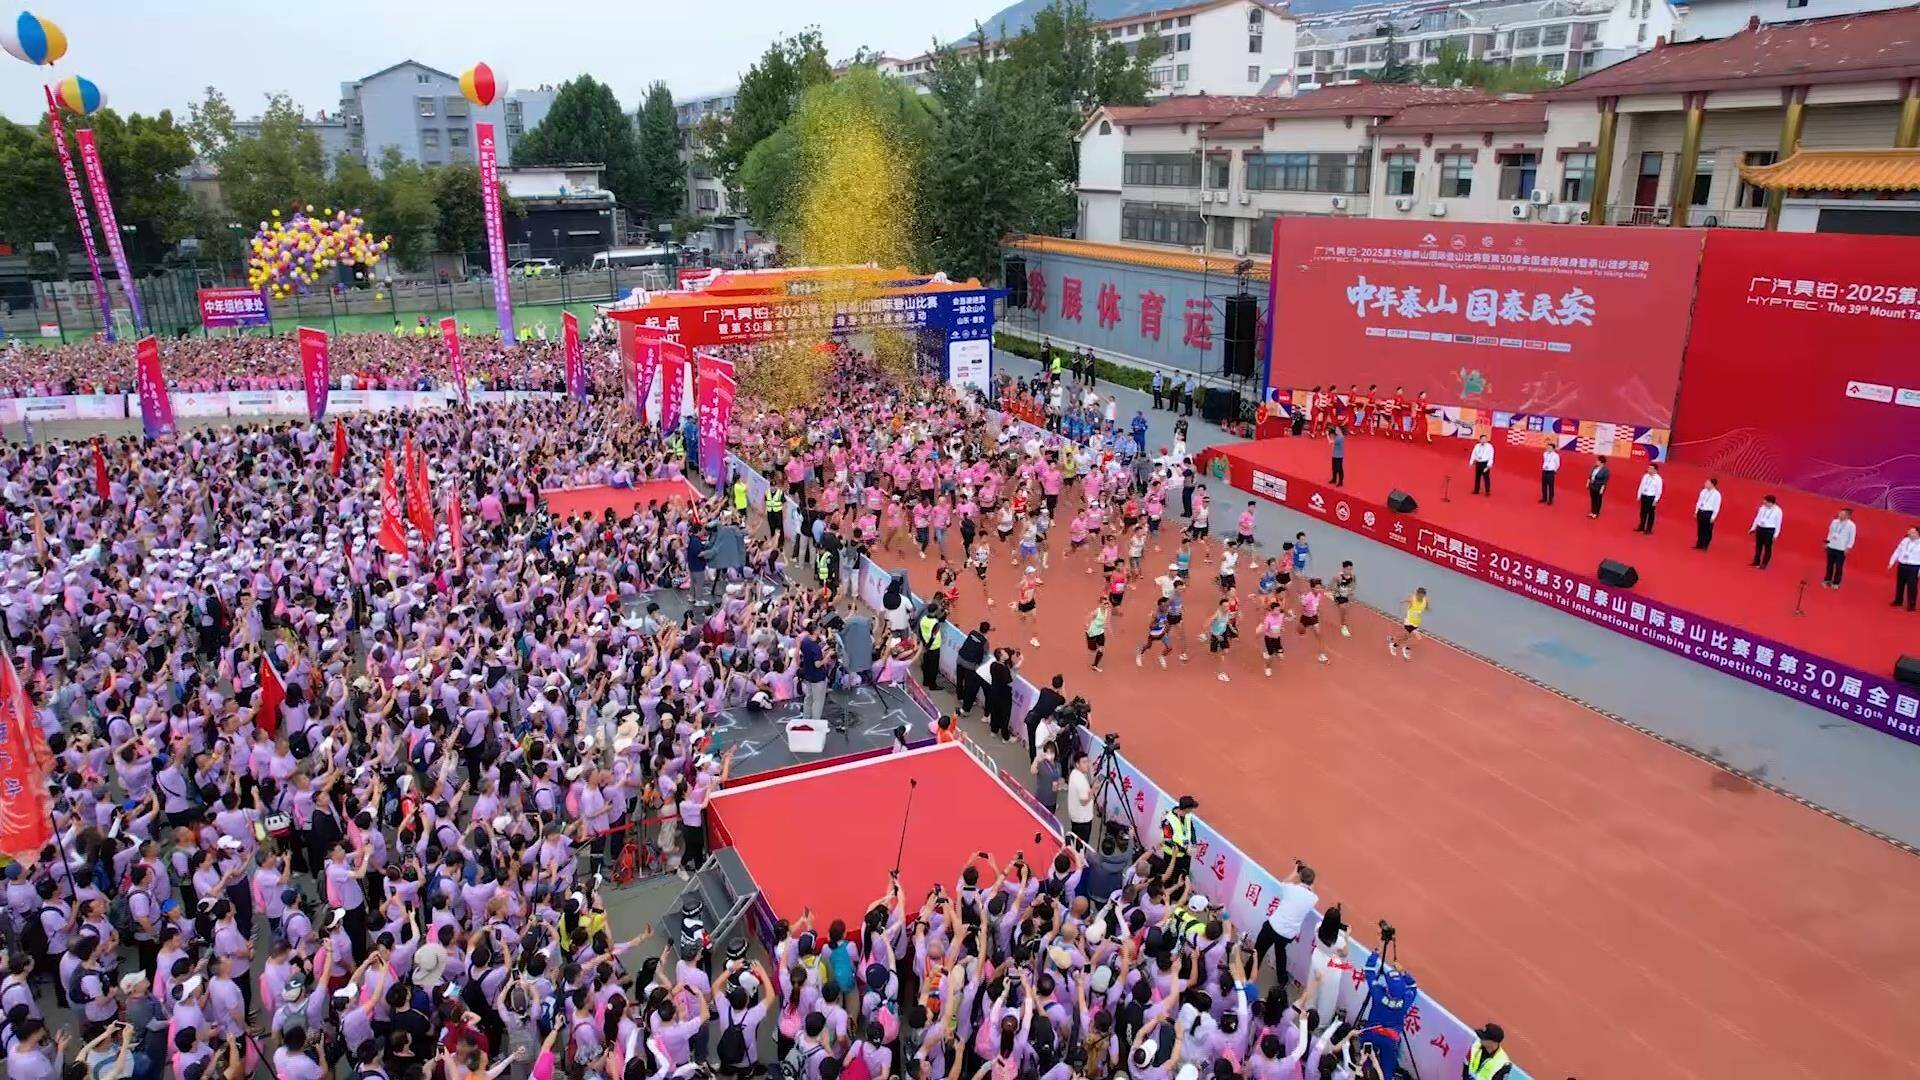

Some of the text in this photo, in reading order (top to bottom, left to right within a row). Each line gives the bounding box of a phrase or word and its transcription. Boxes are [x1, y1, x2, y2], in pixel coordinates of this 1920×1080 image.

[1346, 274, 1596, 328] 中华泰山 国泰民安
[1747, 295, 1818, 312] HYPTEC
[1827, 302, 1846, 315] The
[1870, 306, 1906, 319] Mount
[1417, 543, 1478, 573] HYPTEC
[1489, 570, 1504, 583] The
[1506, 575, 1524, 588] 39th
[1525, 583, 1553, 601] Mount
[1556, 593, 1570, 607] Tai
[1572, 600, 1639, 633] International
[1642, 627, 1691, 654] Climbing
[1695, 646, 1772, 682] Competition
[1775, 675, 1807, 695] 2025
[1826, 694, 1850, 711] the
[1854, 704, 1884, 720] 30th
